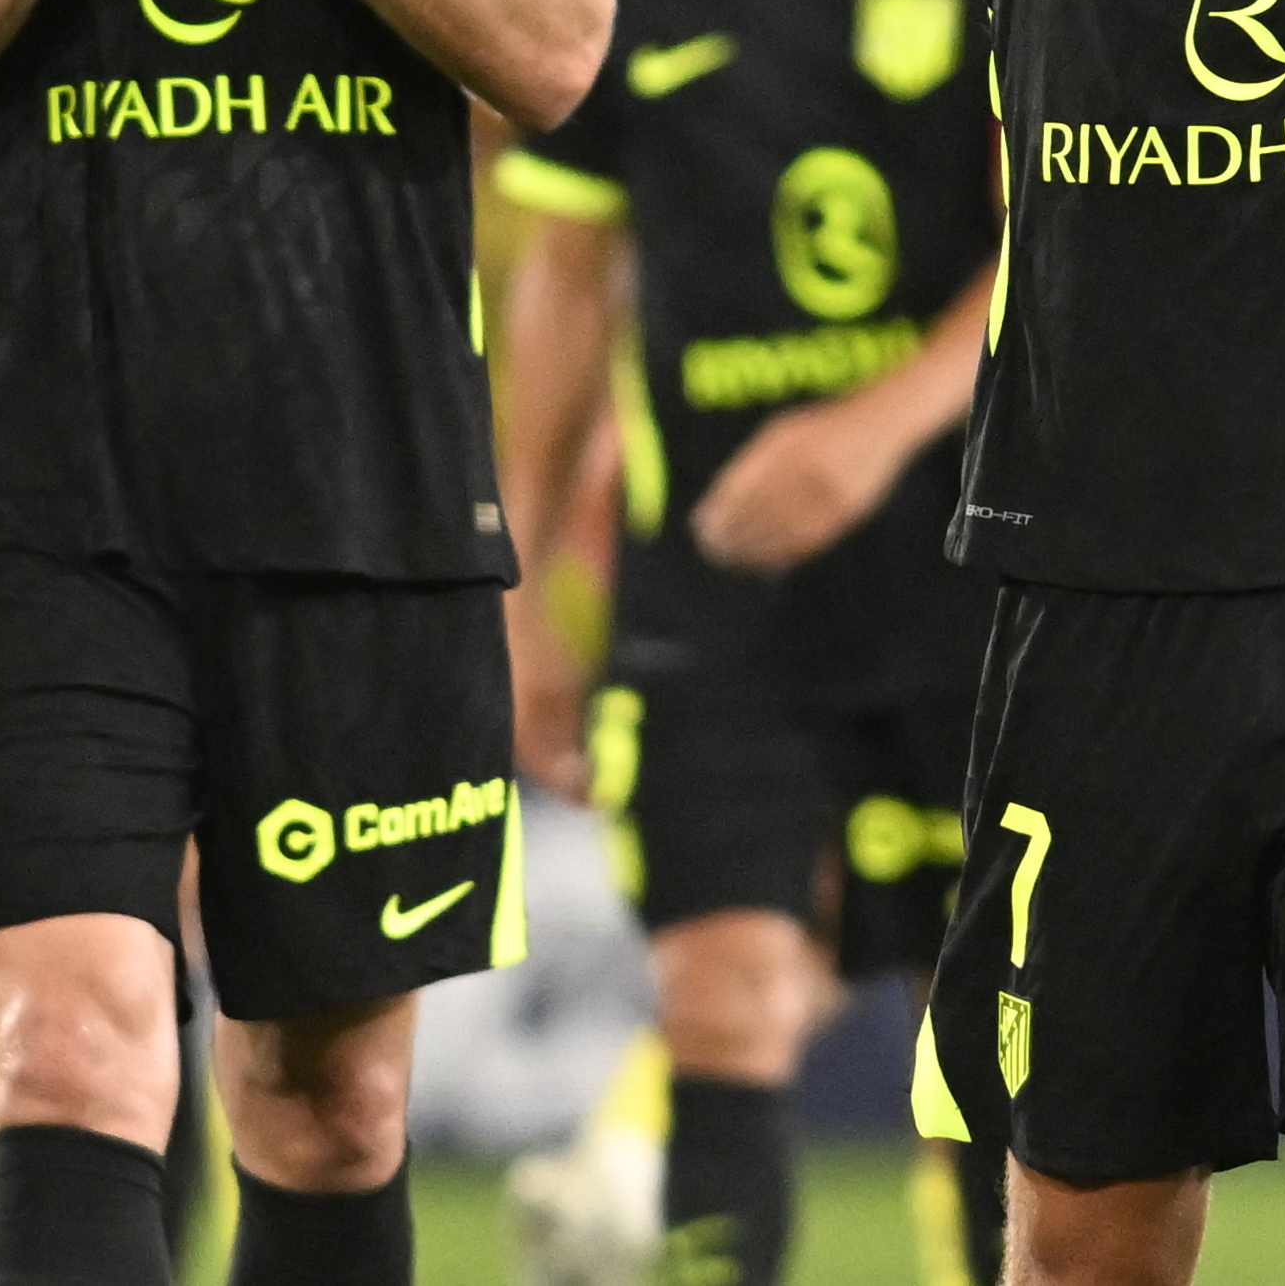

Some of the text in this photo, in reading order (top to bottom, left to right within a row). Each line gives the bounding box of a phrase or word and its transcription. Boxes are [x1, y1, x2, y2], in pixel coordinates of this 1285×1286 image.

[47, 73, 396, 143] RIYADH AIR
[344, 776, 506, 852] ComAve
[999, 802, 1052, 969] 7
